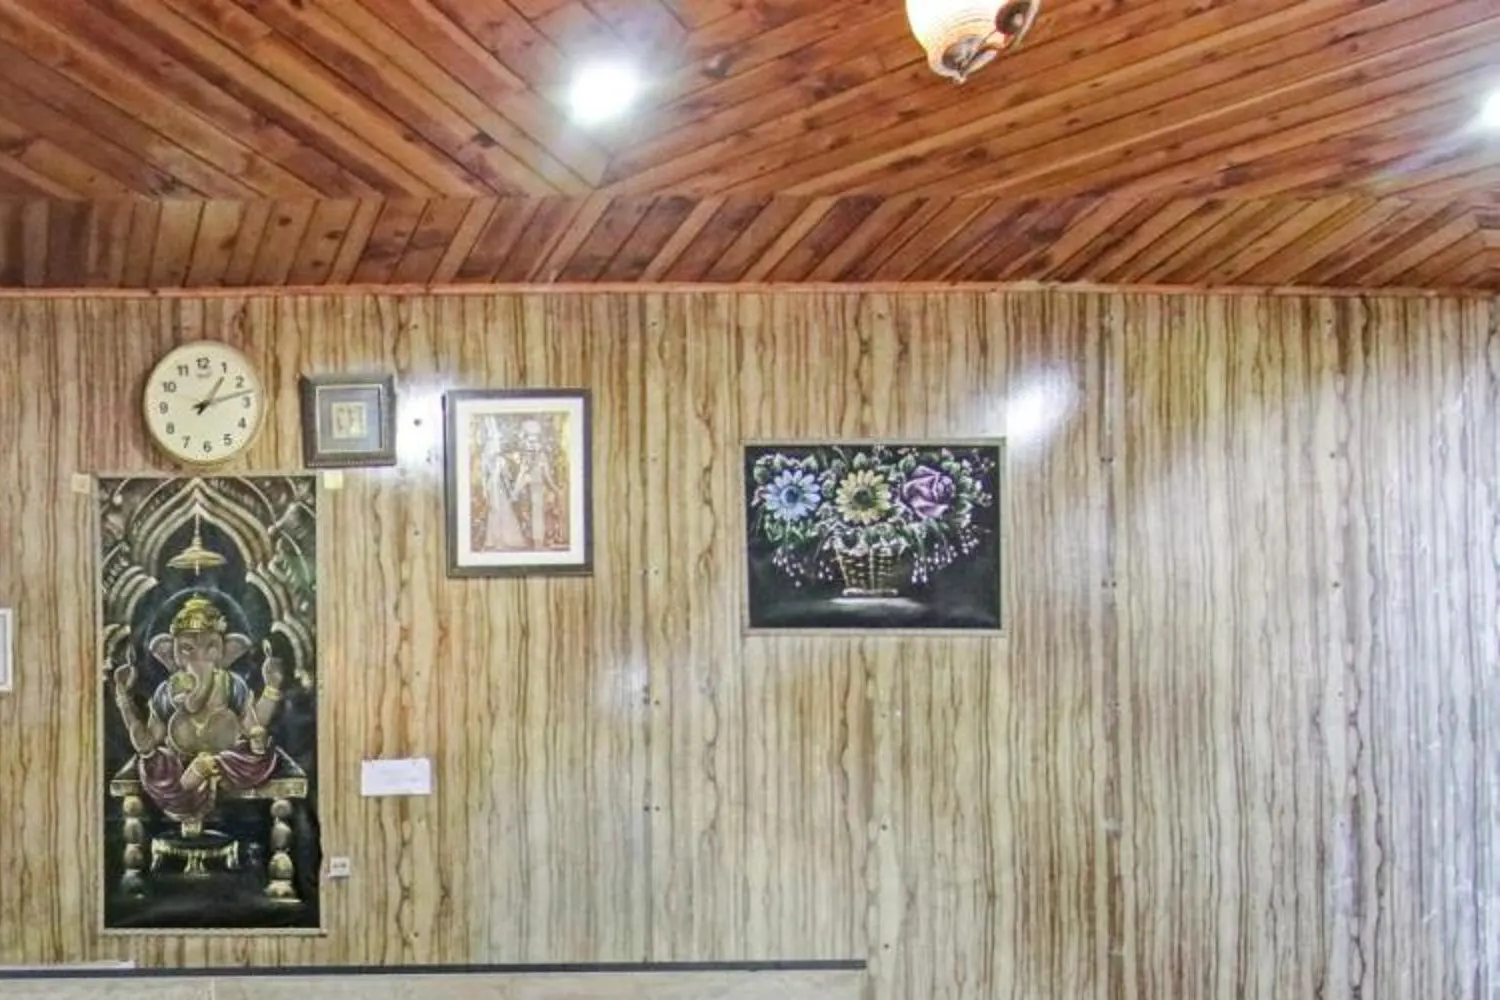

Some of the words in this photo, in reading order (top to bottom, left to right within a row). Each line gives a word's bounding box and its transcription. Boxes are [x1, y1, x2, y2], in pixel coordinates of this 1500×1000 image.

[196, 357, 210, 369] 12
[221, 361, 227, 374] 1
[177, 364, 189, 377] 11
[162, 381, 177, 393] 10
[235, 375, 244, 388] 2
[159, 402, 169, 414] 9
[241, 396, 251, 409] 3
[165, 421, 175, 435] 8
[238, 417, 246, 429] 4
[182, 435, 191, 449] 7
[223, 433, 233, 446] 5
[202, 440, 212, 453] 6
